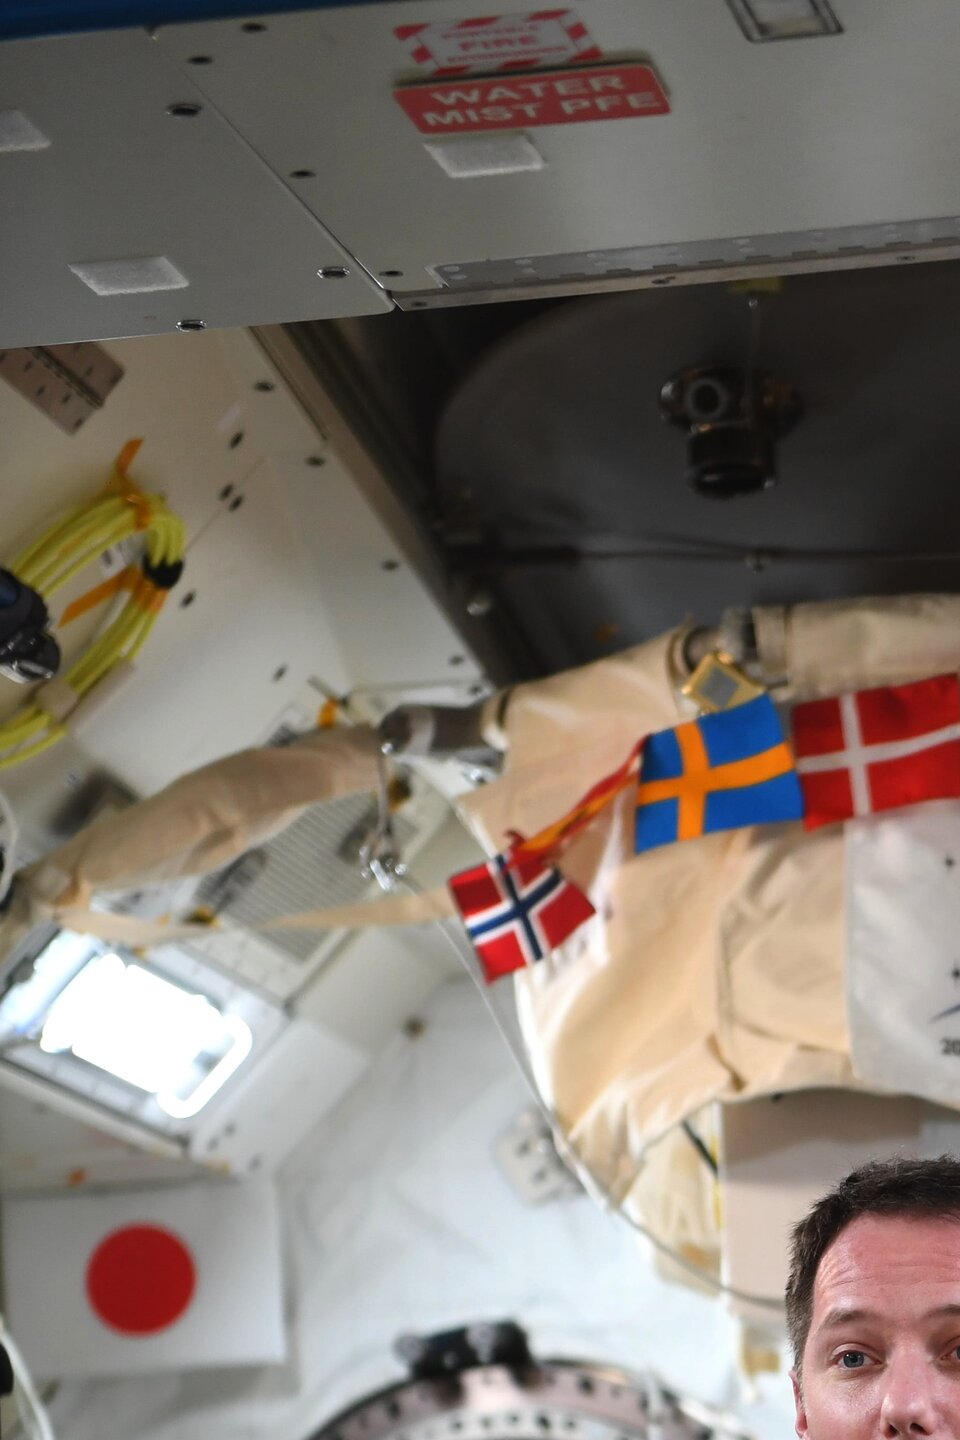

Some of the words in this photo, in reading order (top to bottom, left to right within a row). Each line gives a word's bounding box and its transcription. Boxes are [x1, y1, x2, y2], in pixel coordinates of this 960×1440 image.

[432, 76, 624, 105] WATER
[423, 104, 539, 126] MIST
[562, 93, 660, 115] PFE
